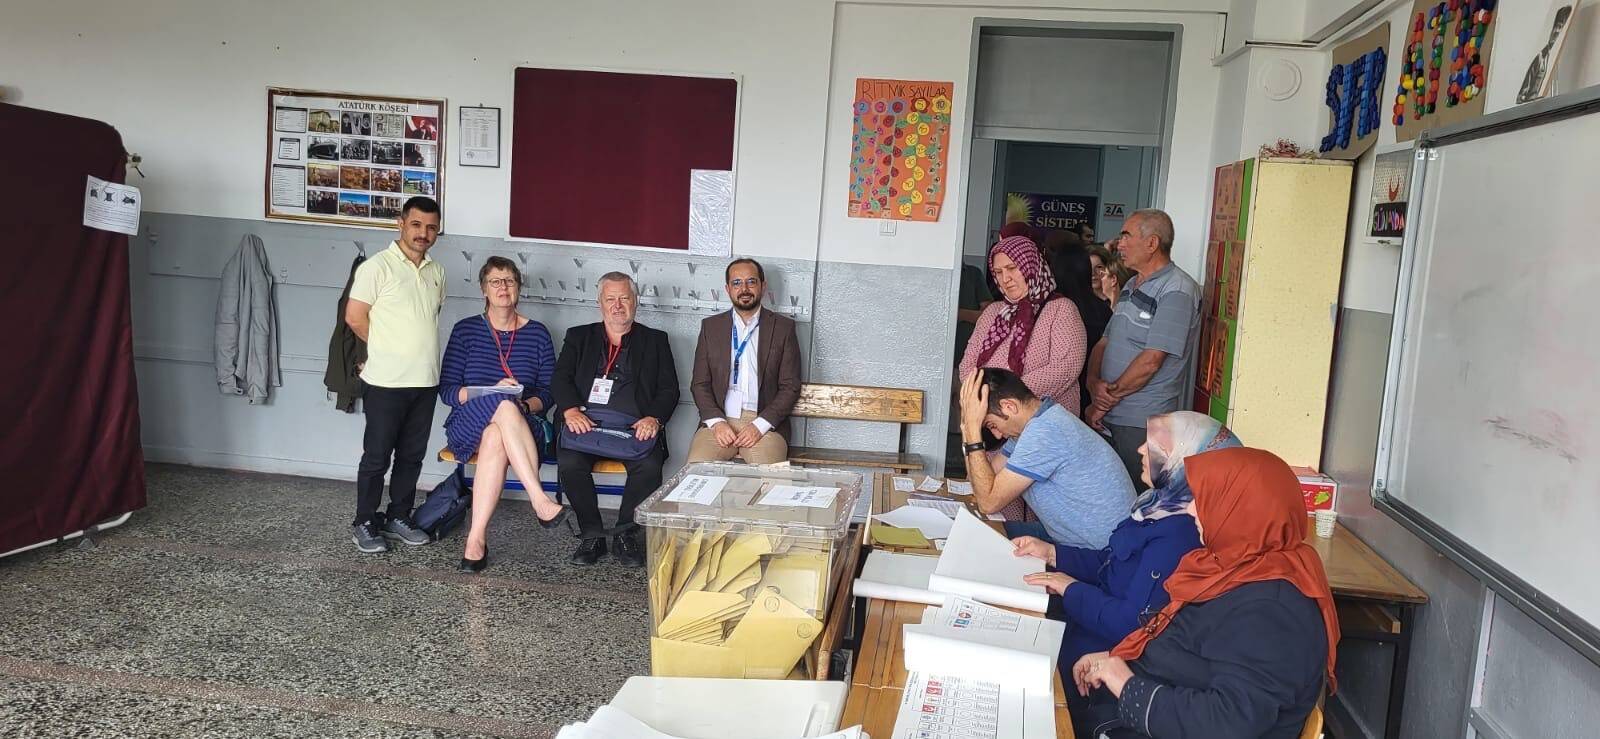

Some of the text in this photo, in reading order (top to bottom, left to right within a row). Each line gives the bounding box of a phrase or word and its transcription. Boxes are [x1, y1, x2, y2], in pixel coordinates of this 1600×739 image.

[909, 84, 947, 98] SAYILAR
[338, 100, 409, 113] ATATÜRK KÖŞESİ
[1041, 199, 1085, 215] GÜNEŞ
[1105, 205, 1123, 215] 2/A
